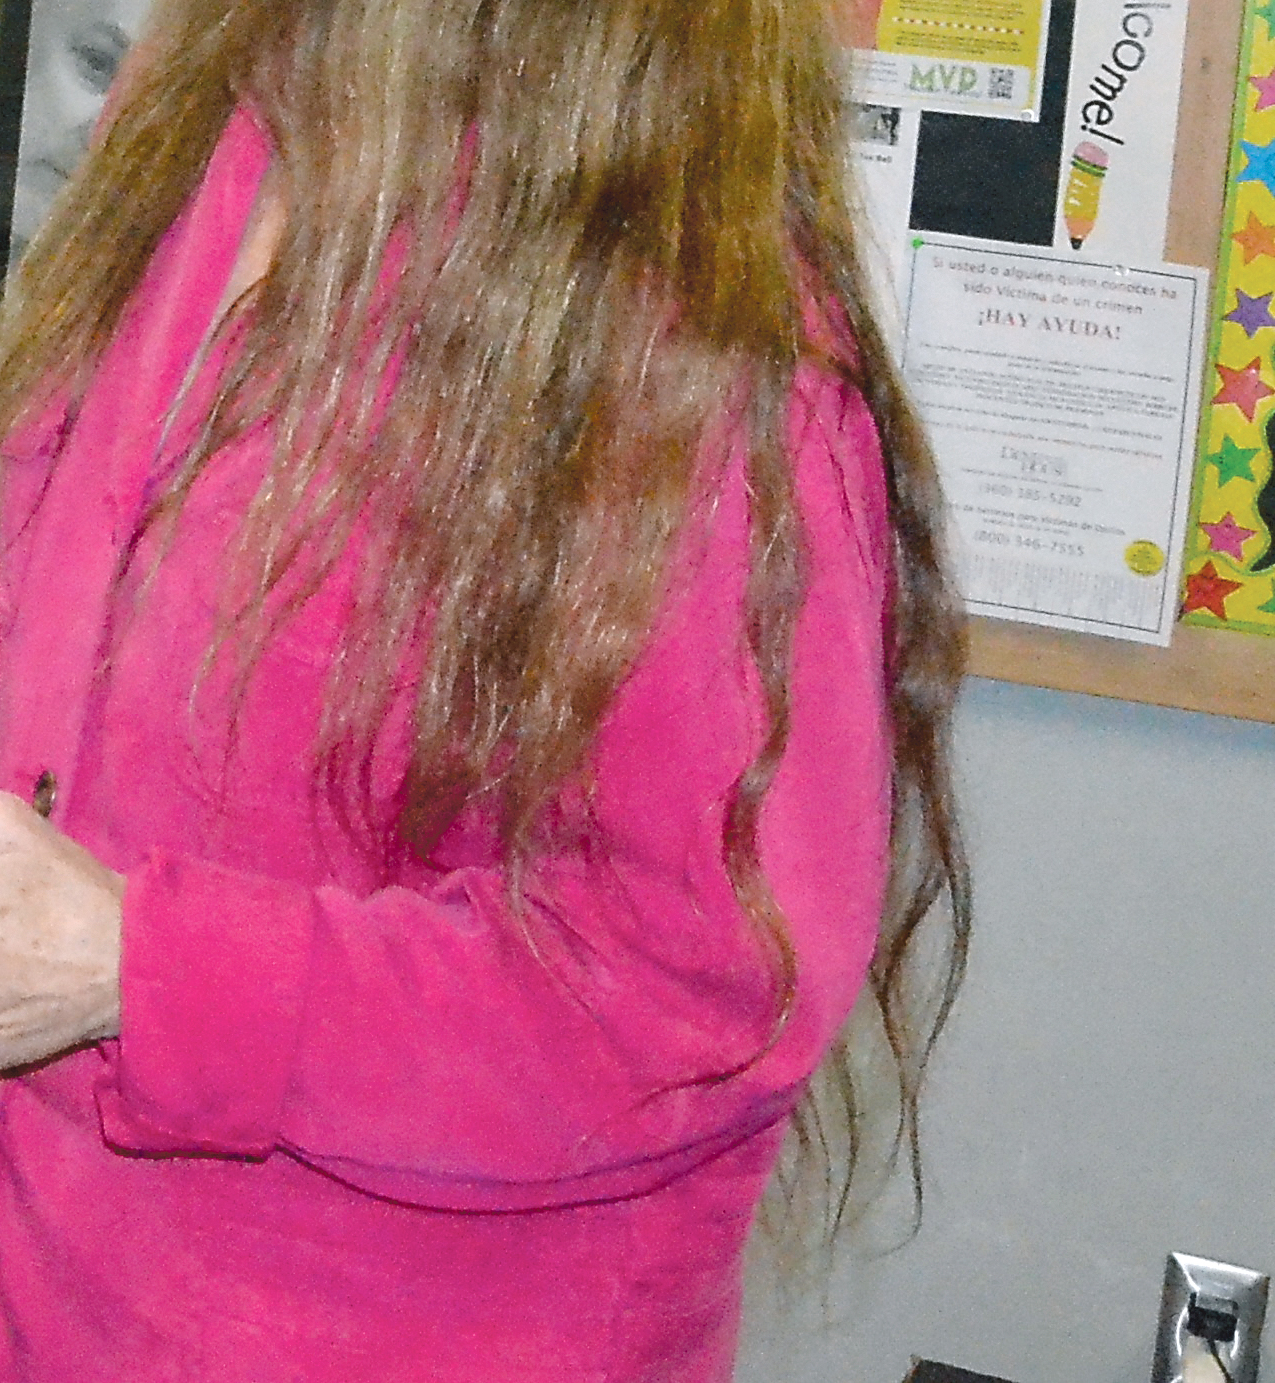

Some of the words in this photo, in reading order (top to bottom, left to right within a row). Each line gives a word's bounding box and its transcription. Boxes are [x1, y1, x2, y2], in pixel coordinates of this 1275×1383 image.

[933, 256, 944, 269] Si
[949, 260, 986, 275] usted
[1003, 264, 1051, 283] alguien
[1101, 279, 1157, 297] conoces
[1160, 286, 1178, 300] ha
[964, 282, 992, 295] sido
[1051, 293, 1069, 306] de
[1072, 297, 1091, 308] un
[1095, 300, 1143, 315] crimen
[978, 308, 1029, 328] ¡HAY
[1038, 315, 1121, 341] AYUDA!
